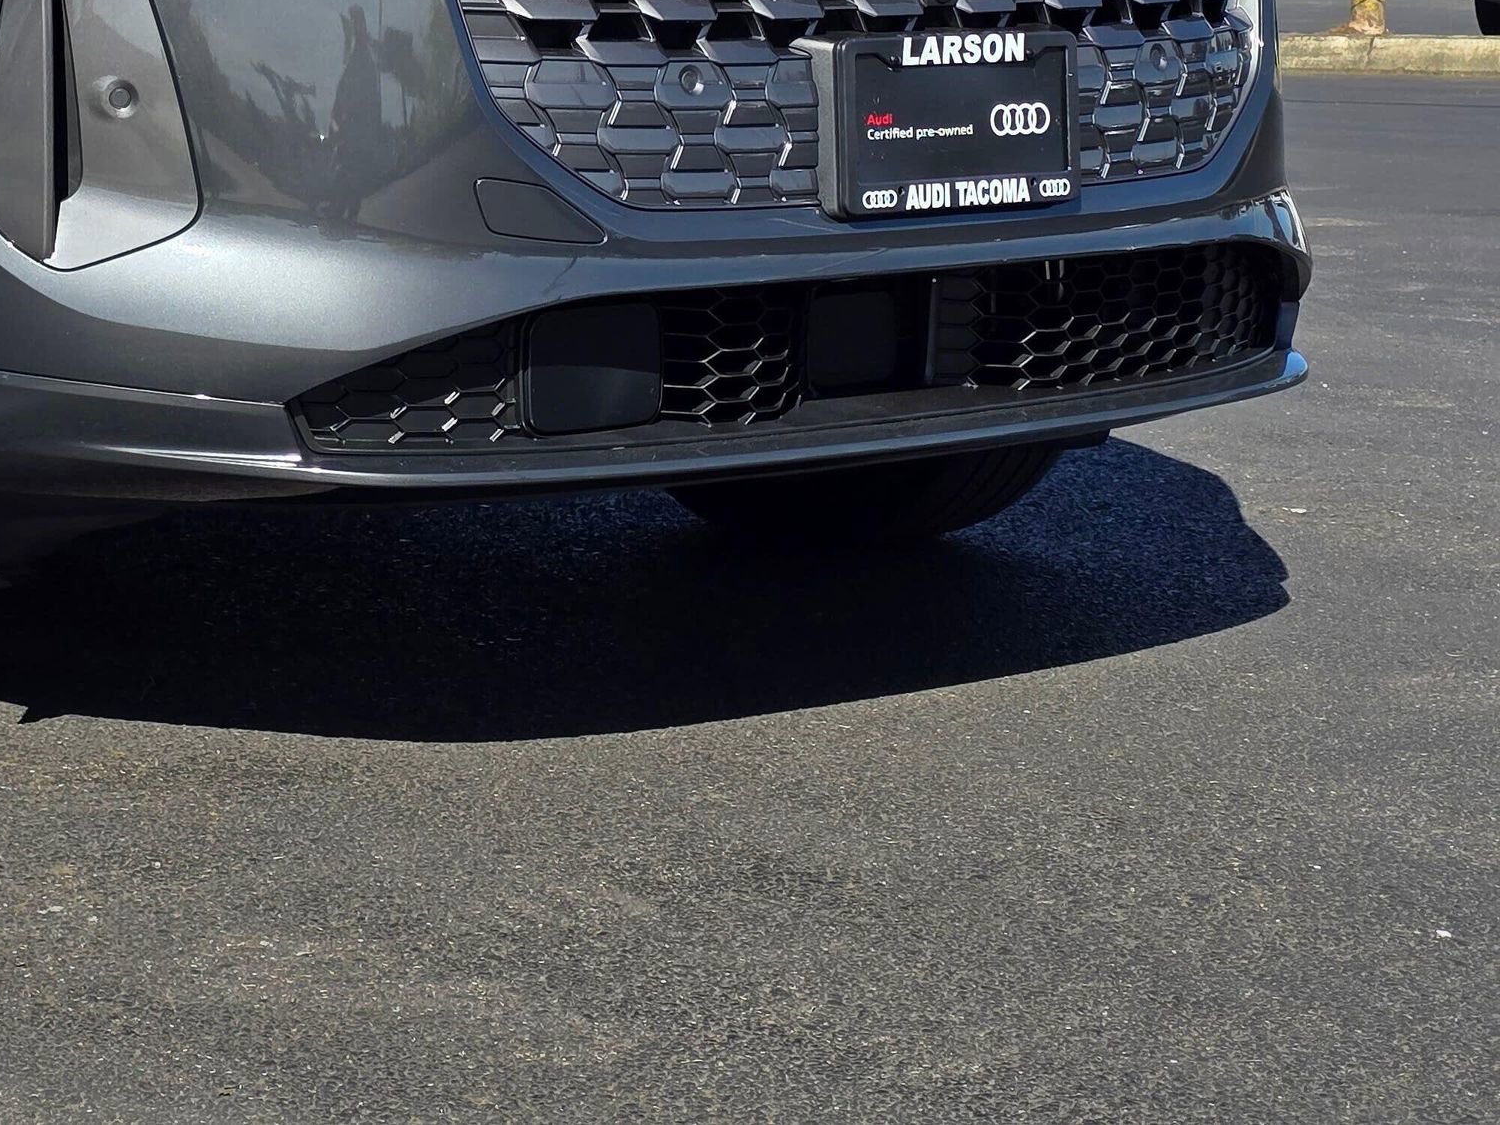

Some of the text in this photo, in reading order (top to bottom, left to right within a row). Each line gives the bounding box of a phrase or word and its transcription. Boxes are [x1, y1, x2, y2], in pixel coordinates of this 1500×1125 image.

[902, 33, 1026, 66] LARSON
[867, 113, 893, 125] Audi
[867, 124, 974, 141] Certified pre-owned
[905, 178, 1030, 210] AUDI TACOMA
